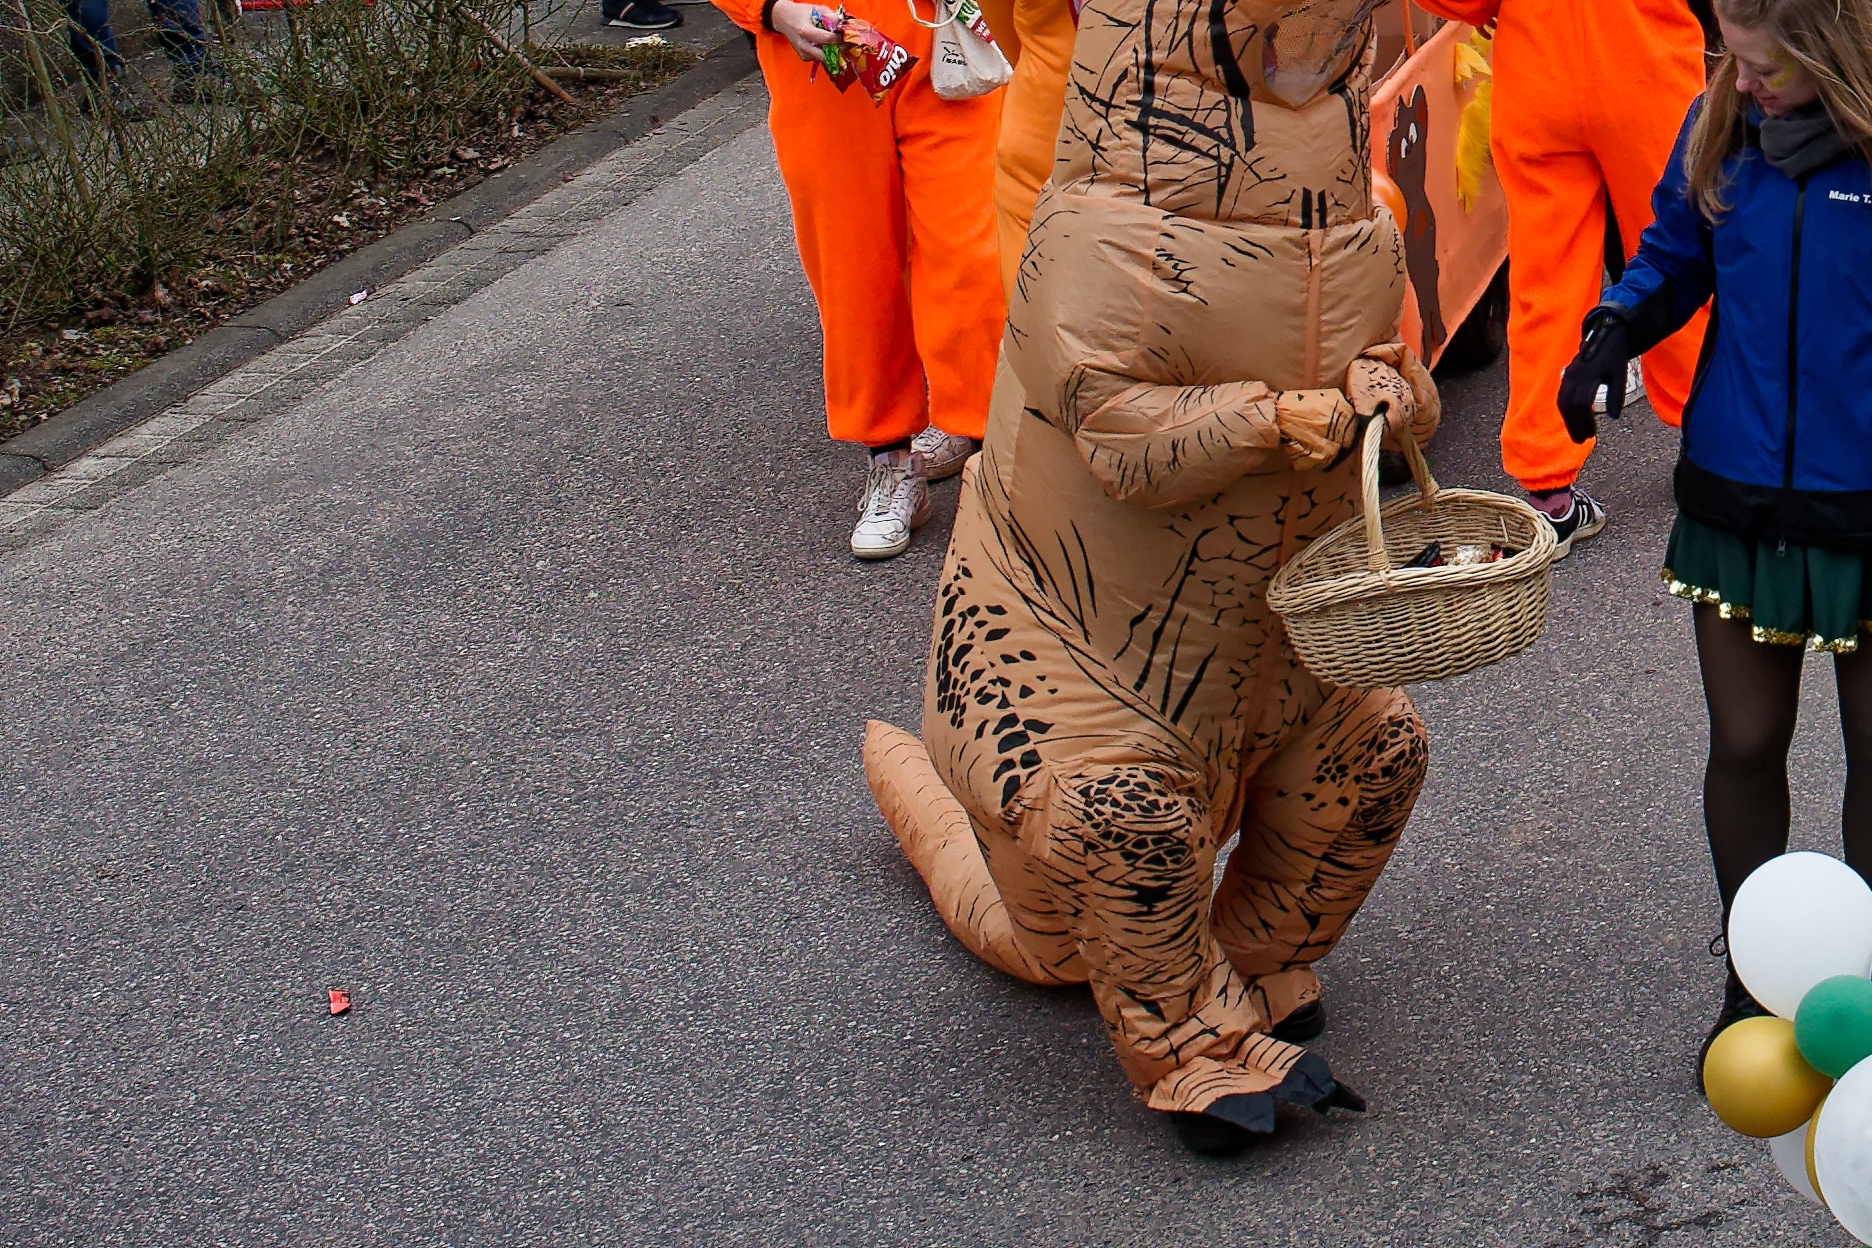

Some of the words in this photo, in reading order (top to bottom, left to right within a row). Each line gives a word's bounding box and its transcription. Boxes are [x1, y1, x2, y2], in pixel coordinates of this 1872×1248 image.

[879, 45, 908, 87] Chio
[1829, 189, 1860, 202] Marie
[1862, 193, 1872, 204] T.
